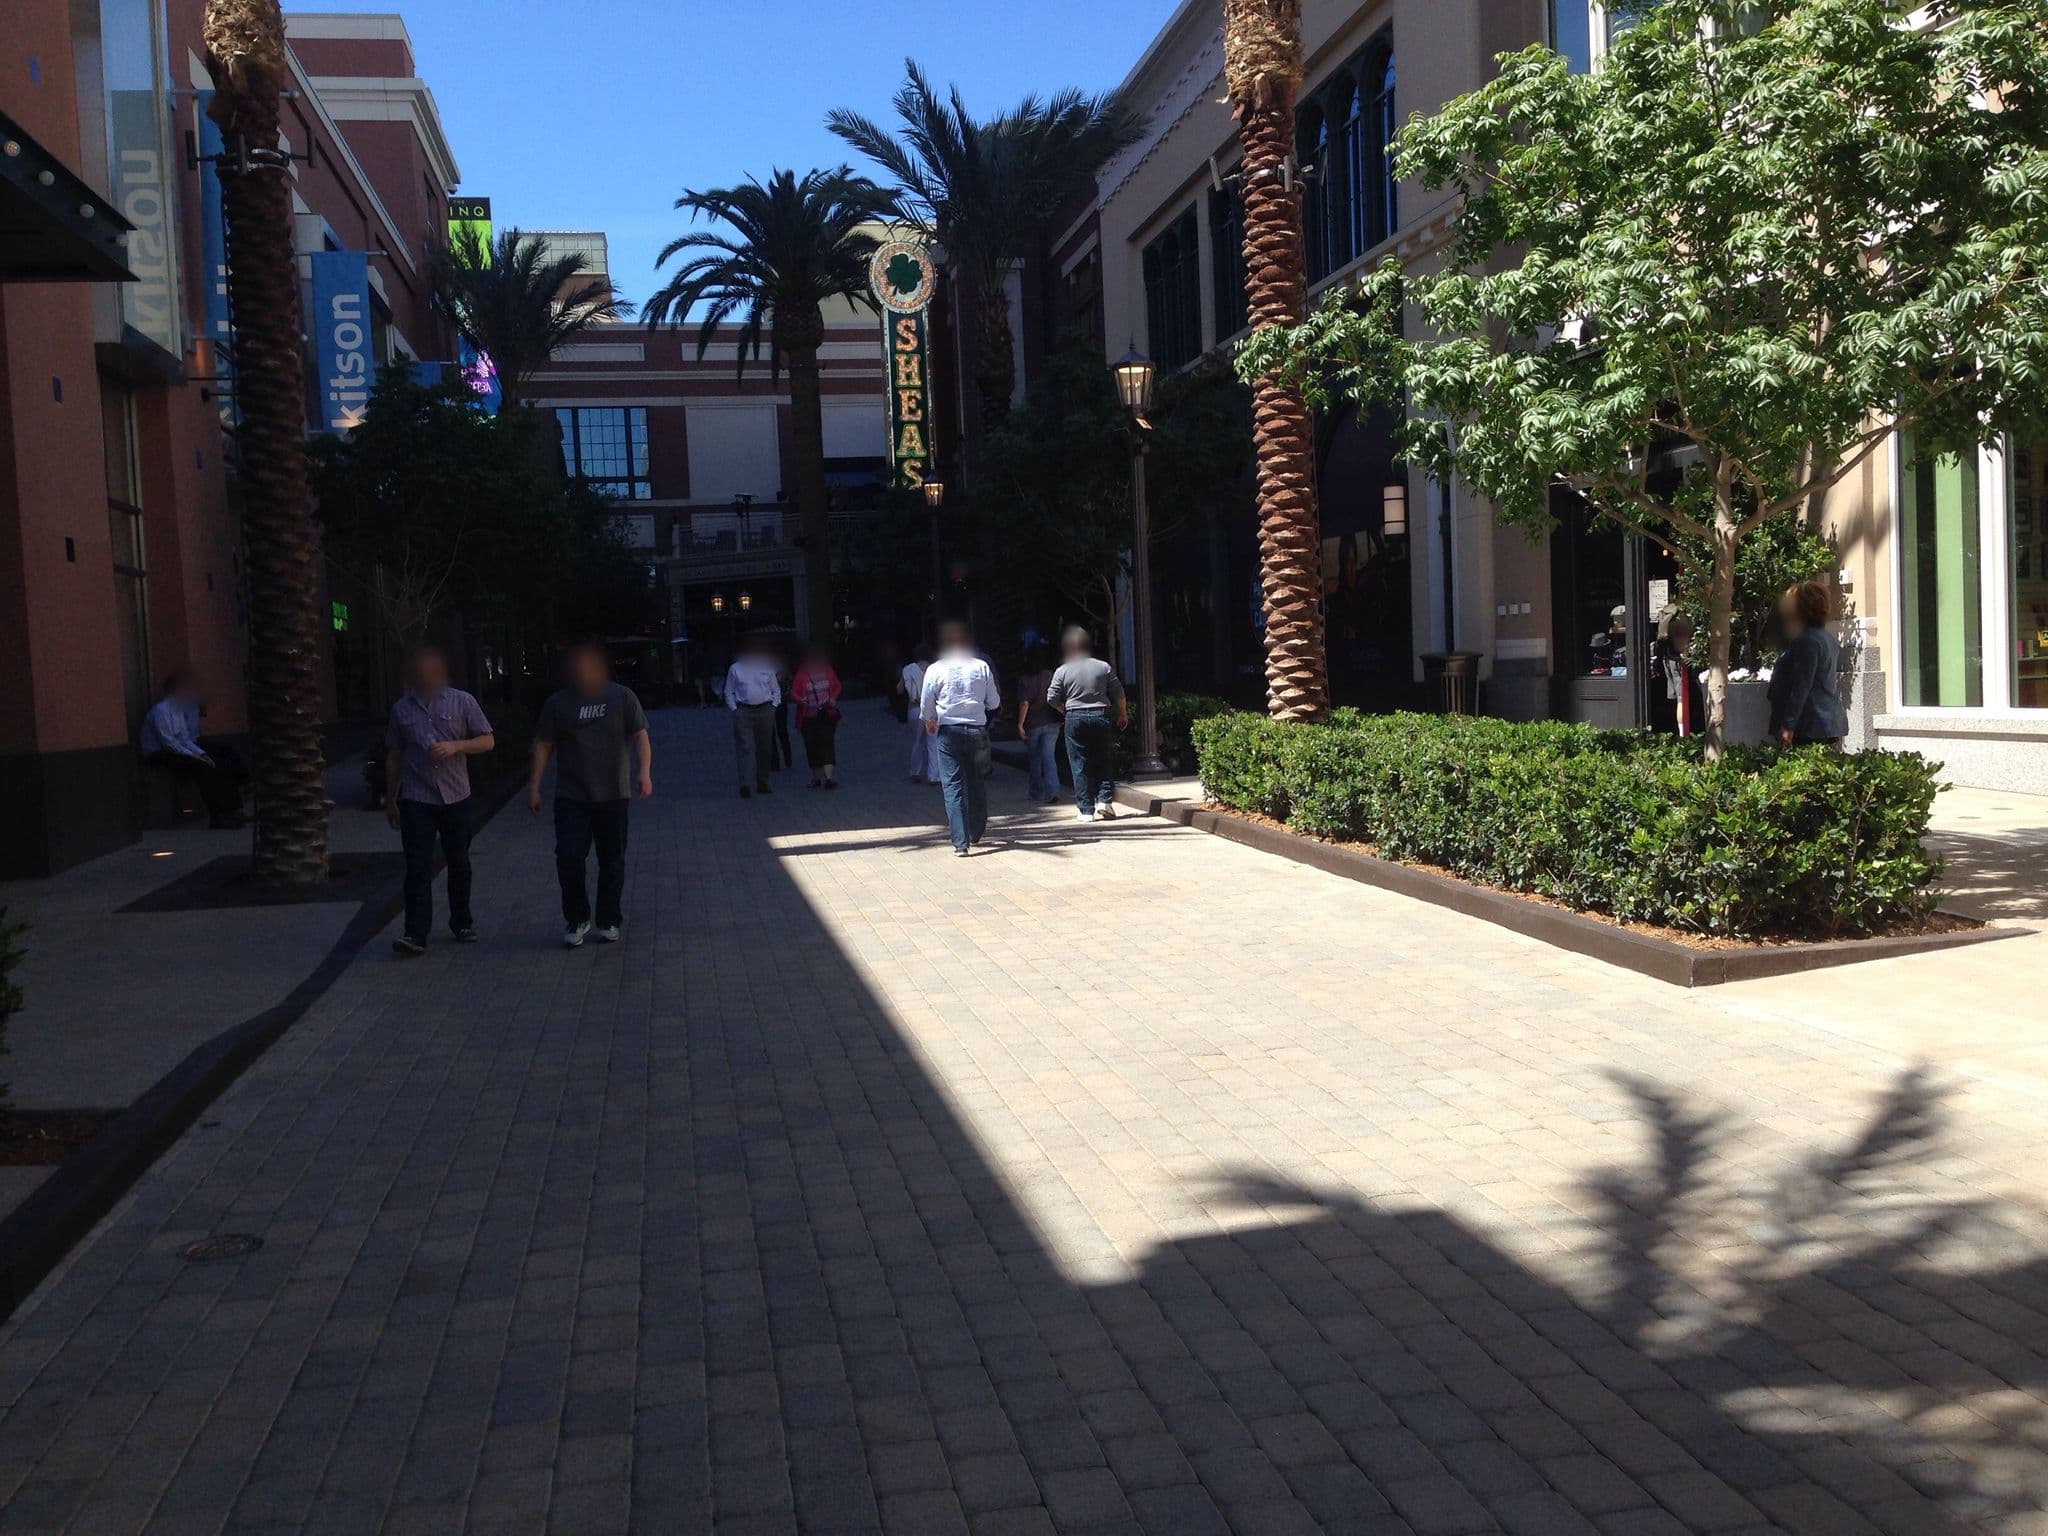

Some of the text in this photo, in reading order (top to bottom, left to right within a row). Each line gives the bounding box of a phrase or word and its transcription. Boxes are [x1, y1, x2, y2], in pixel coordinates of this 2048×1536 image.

[329, 293, 369, 428] kitson
[895, 318, 927, 491] SHEAS
[579, 703, 607, 720] NIKE
